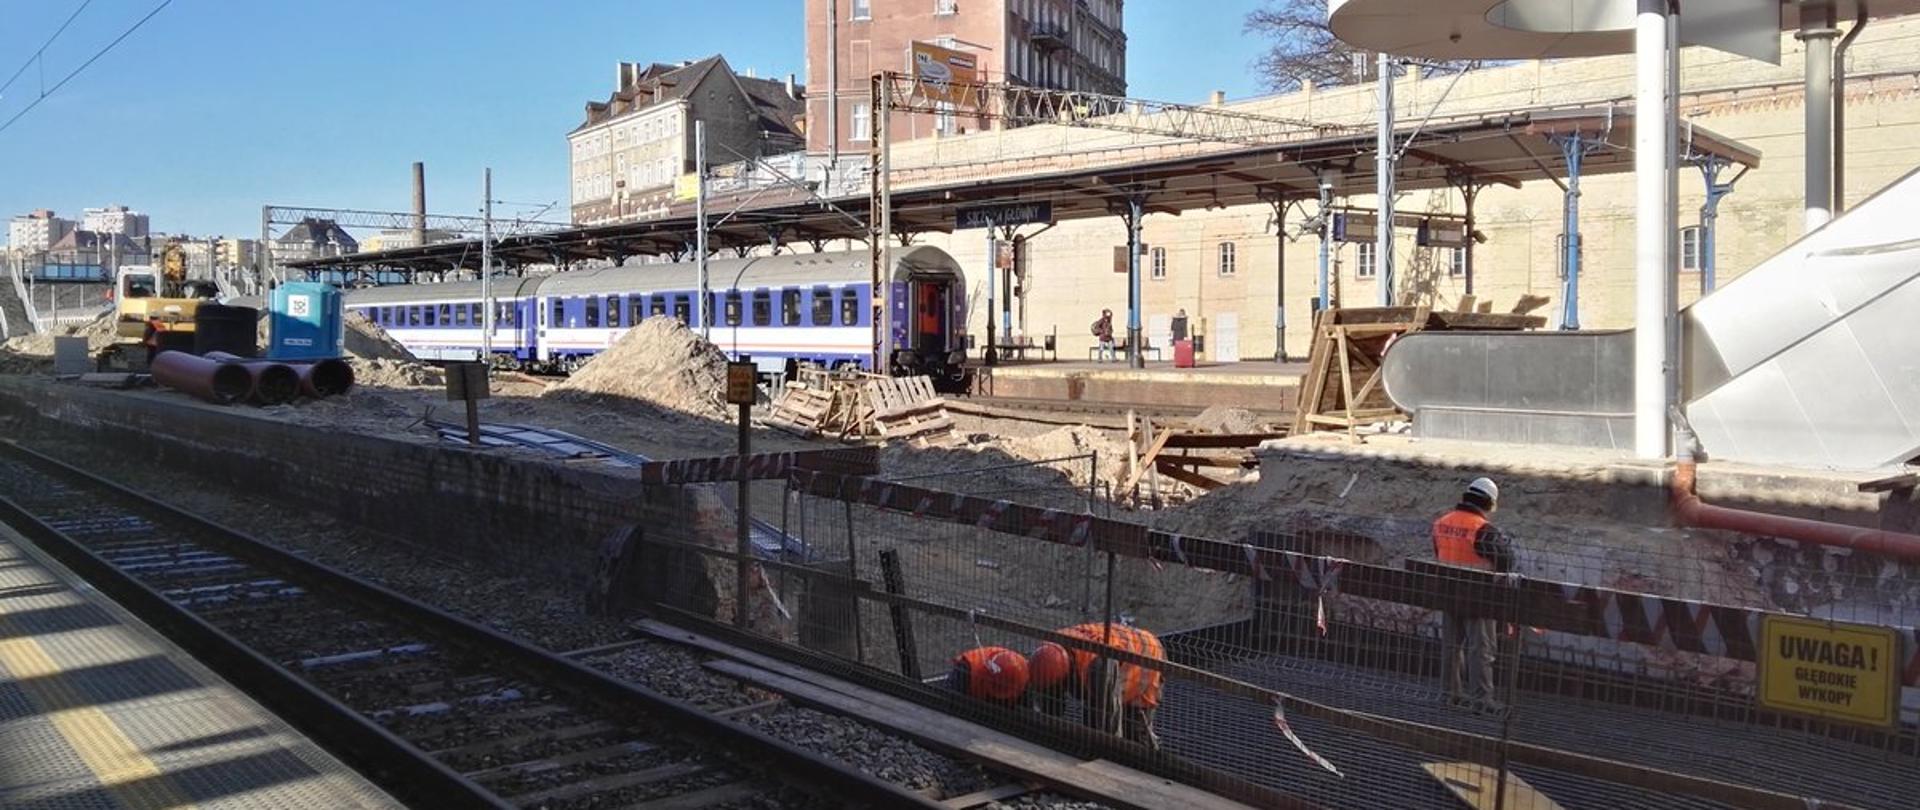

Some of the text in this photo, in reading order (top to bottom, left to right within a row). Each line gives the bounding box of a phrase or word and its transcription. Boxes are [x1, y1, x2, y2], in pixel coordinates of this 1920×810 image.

[966, 208, 1003, 225] SZCZN
[1795, 666, 1857, 688] GŁĘBOKIE
[1799, 685, 1853, 707] WYKOPY
